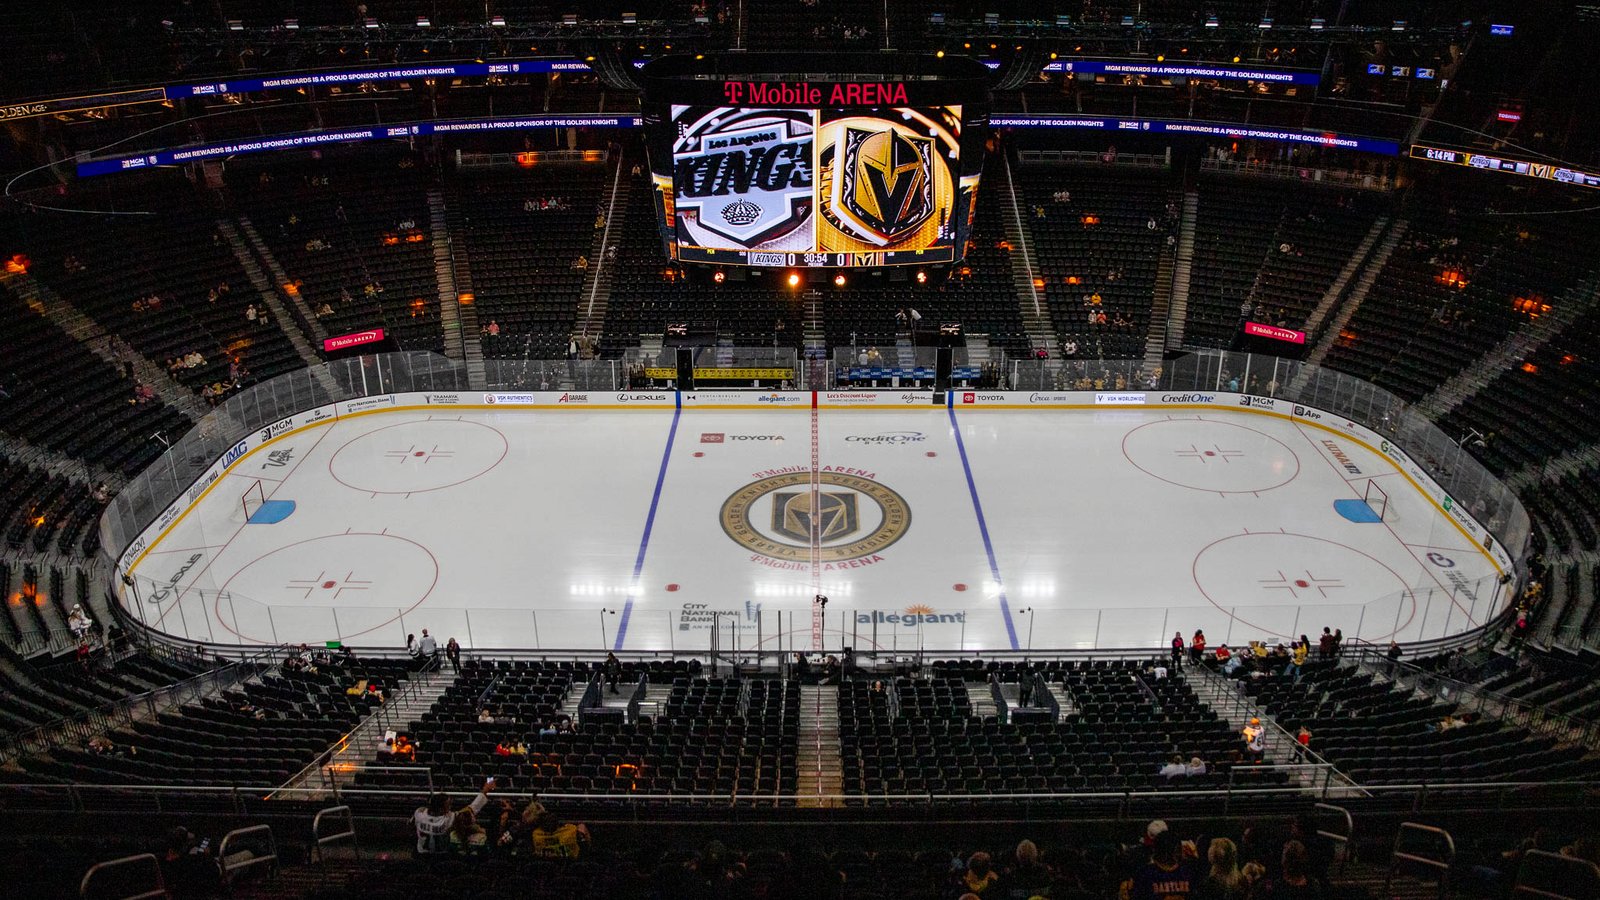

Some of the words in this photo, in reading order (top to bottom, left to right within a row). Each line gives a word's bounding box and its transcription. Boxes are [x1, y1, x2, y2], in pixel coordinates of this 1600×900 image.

[281, 77, 312, 85] REWARDS
[748, 82, 821, 104] Mobile
[830, 84, 908, 104] ARENA
[192, 147, 224, 156] REWARDS
[262, 139, 293, 148] SPONSOR
[344, 131, 372, 139] KNIGHTS
[708, 140, 729, 150] Los
[731, 132, 778, 146] Angeles
[1302, 135, 1328, 143] GOLDEN
[1329, 138, 1358, 147] KNIGHTS
[1427, 150, 1442, 160] 6:14
[1444, 152, 1454, 162] PM
[755, 254, 782, 263] KINGS
[788, 254, 796, 266] 0
[804, 253, 828, 263] 30:54
[837, 254, 844, 266] 0
[758, 395, 800, 403] allegiant.com
[1030, 392, 1050, 403] Circa
[1252, 397, 1274, 406] MGM
[272, 418, 292, 432] MGM
[222, 441, 248, 470] UMC
[823, 466, 876, 479] ARENA
[880, 494, 901, 524] GOLDEN
[824, 555, 885, 572] ARENA
[857, 611, 966, 626] allegiant
